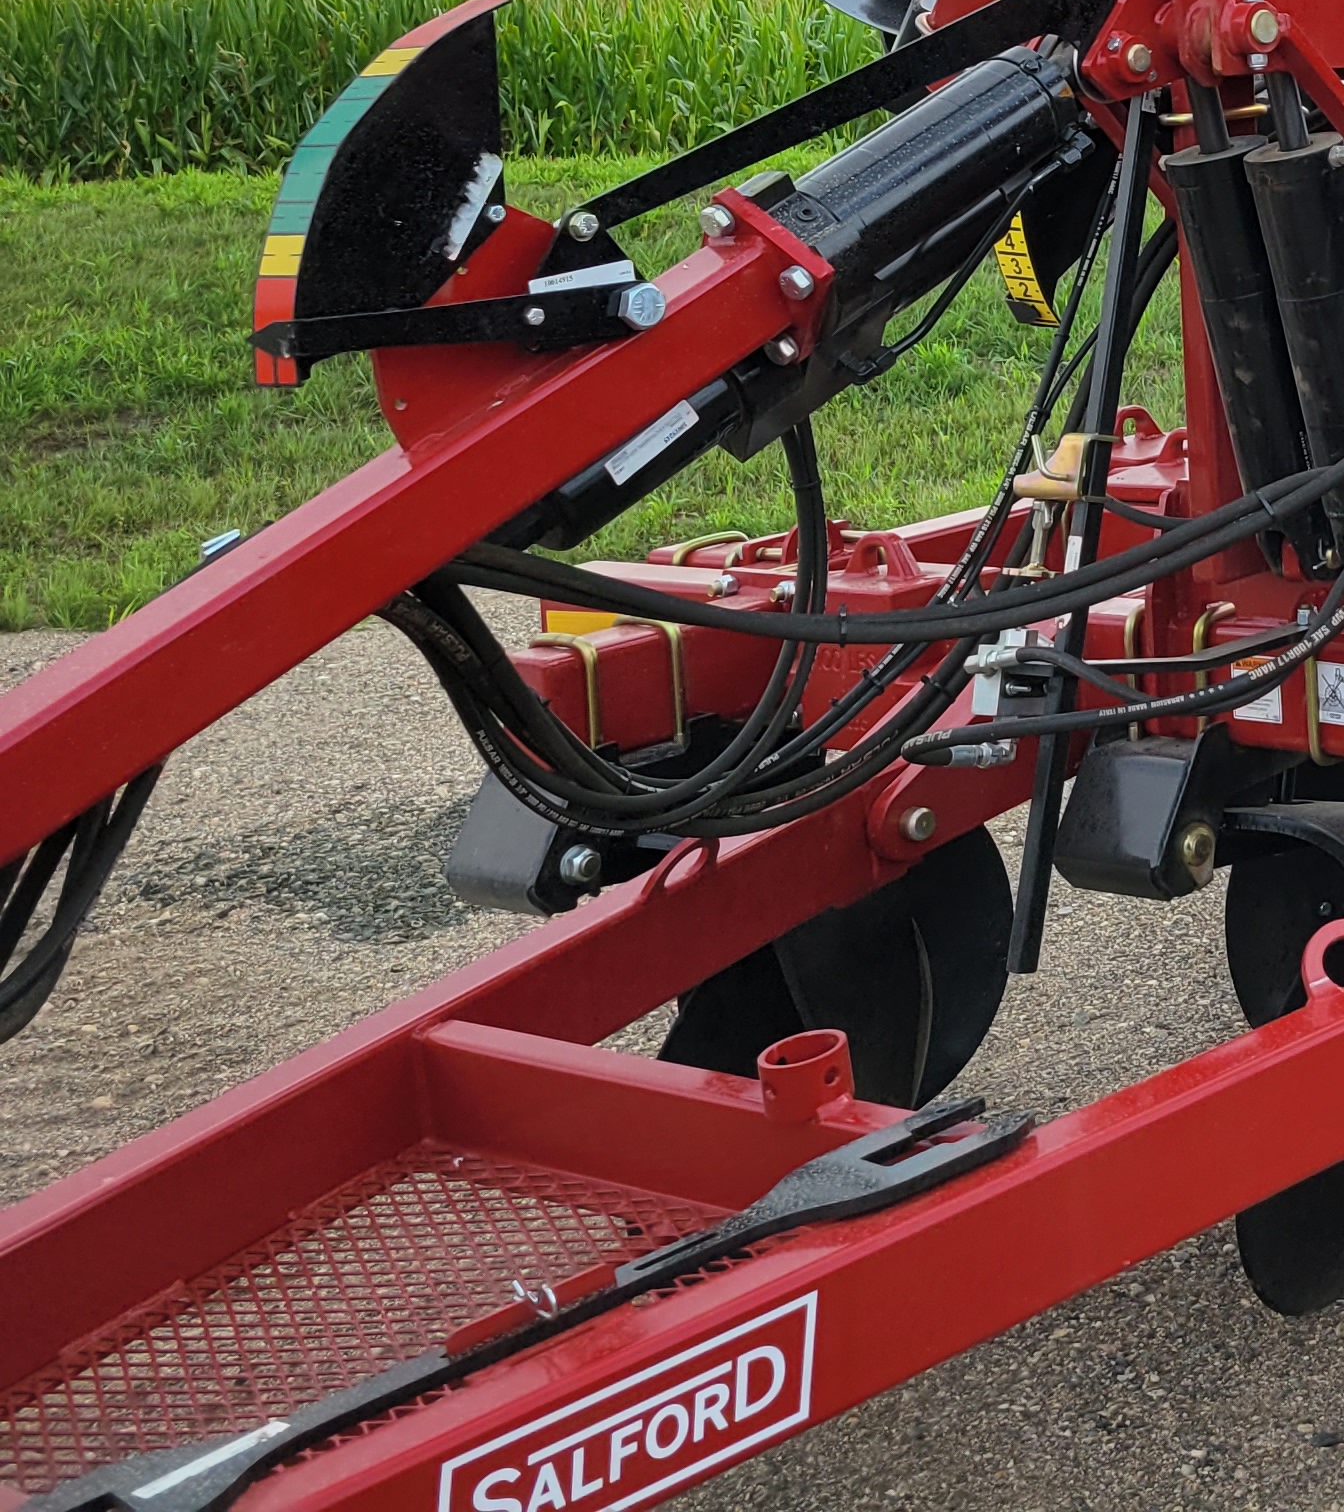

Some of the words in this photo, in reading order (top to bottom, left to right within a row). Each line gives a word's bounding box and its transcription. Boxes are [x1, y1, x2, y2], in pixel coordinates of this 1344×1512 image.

[1004, 232, 1016, 251] 4
[1010, 257, 1023, 275] 3
[1017, 282, 1033, 298] 2
[1311, 625, 1332, 645] SAE
[1278, 639, 1313, 666] 100R17
[1249, 656, 1277, 681] HARC
[1099, 709, 1117, 718] ITALY
[1117, 707, 1127, 715] IN
[1127, 703, 1148, 713] MADE
[475, 730, 501, 764] PULSAR
[471, 1344, 788, 1512] SALFORD
